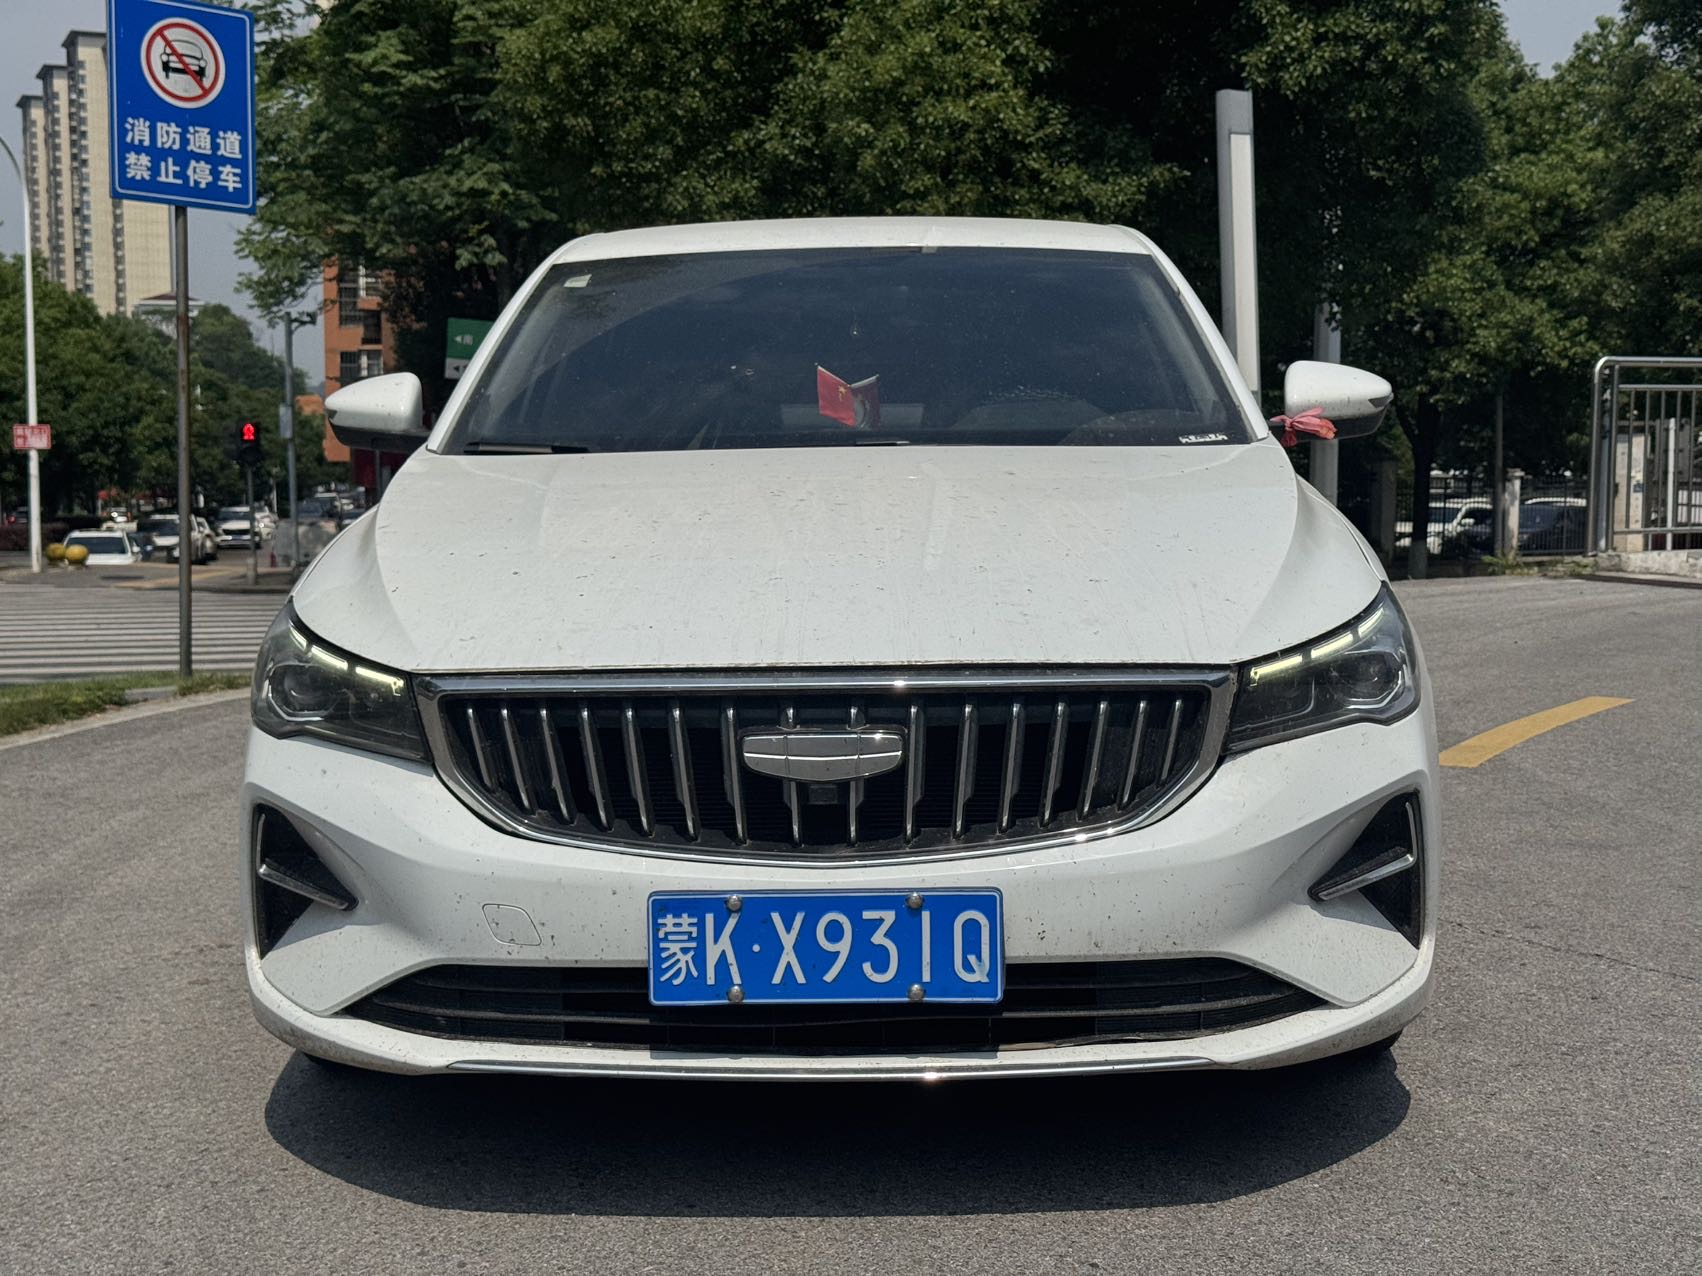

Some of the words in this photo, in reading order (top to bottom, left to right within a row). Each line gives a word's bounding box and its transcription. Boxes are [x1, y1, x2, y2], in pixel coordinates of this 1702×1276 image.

[124, 117, 243, 159] 消防通道
[125, 151, 243, 192] 禁止停车
